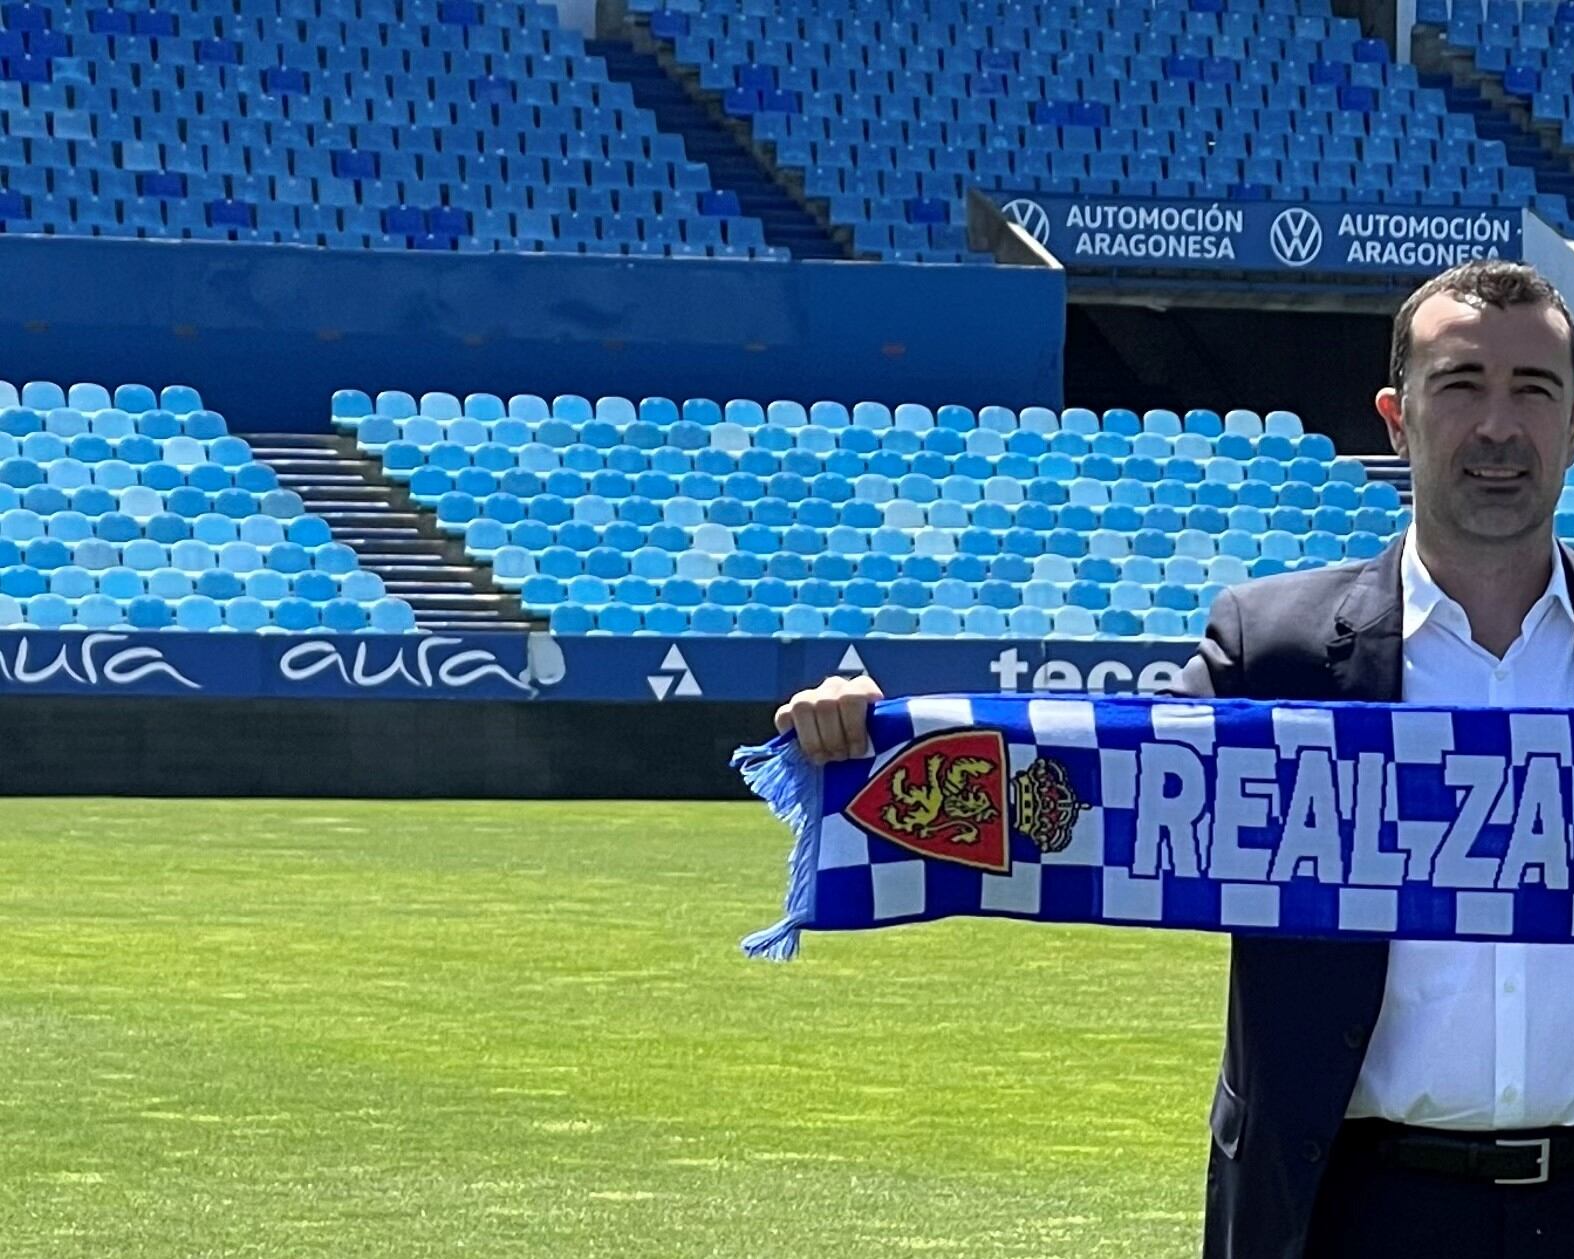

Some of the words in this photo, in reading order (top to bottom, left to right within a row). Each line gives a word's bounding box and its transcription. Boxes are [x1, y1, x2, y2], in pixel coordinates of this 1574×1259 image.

[1066, 202, 1243, 233] AUTOMOCIÓN
[1338, 212, 1510, 242] AUTOMOCIÓN
[1075, 232, 1236, 259] ARAGONESA
[1347, 240, 1499, 266] ARAGONESA
[0, 633, 202, 689] ura
[279, 636, 535, 690] aura
[1129, 740, 1414, 884] REAL
